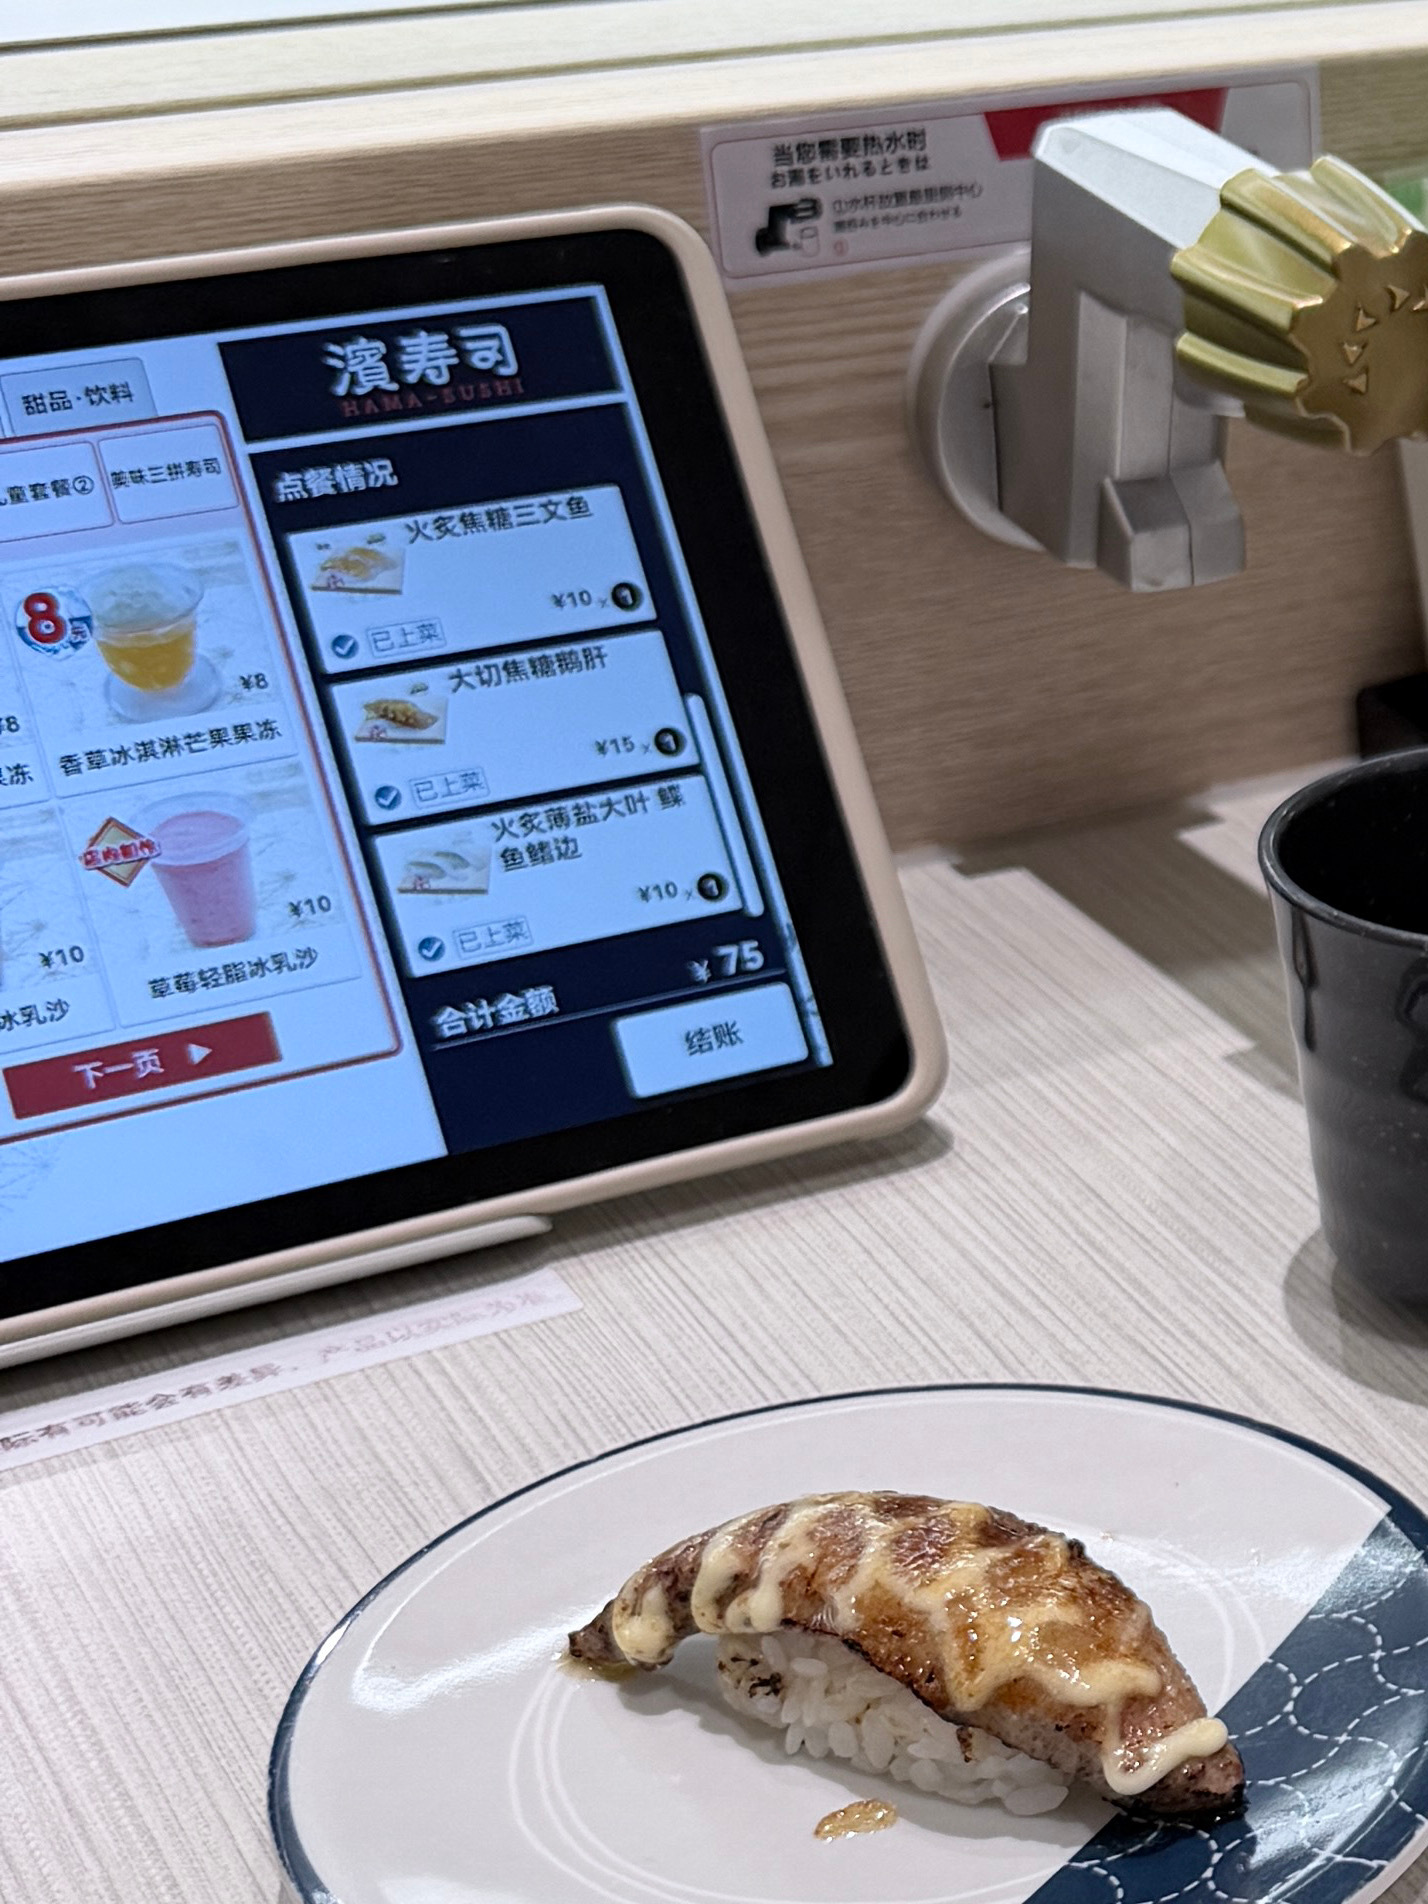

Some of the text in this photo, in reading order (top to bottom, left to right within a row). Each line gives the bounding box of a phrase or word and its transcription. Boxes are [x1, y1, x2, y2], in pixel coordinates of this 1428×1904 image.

[322, 322, 519, 396] 濱寿司
[275, 457, 399, 504] 点餐情况
[404, 495, 595, 545] 火炙焦糖三文鱼
[371, 622, 442, 653] 已上菜
[239, 671, 269, 692] ¥8
[448, 645, 609, 694] 大切焦糖鹅肝
[59, 717, 284, 778] 香草冰淇淋芒果果冻
[413, 771, 486, 803] 已上菜
[288, 894, 332, 919] ¥10
[39, 944, 85, 970] ¥10
[457, 921, 530, 954] 已上菜
[148, 945, 319, 1000] 草莓轻脂冰乳沙
[432, 984, 561, 1040] 合计金额
[683, 1019, 744, 1057] 结账
[72, 1047, 166, 1091] 下一页
